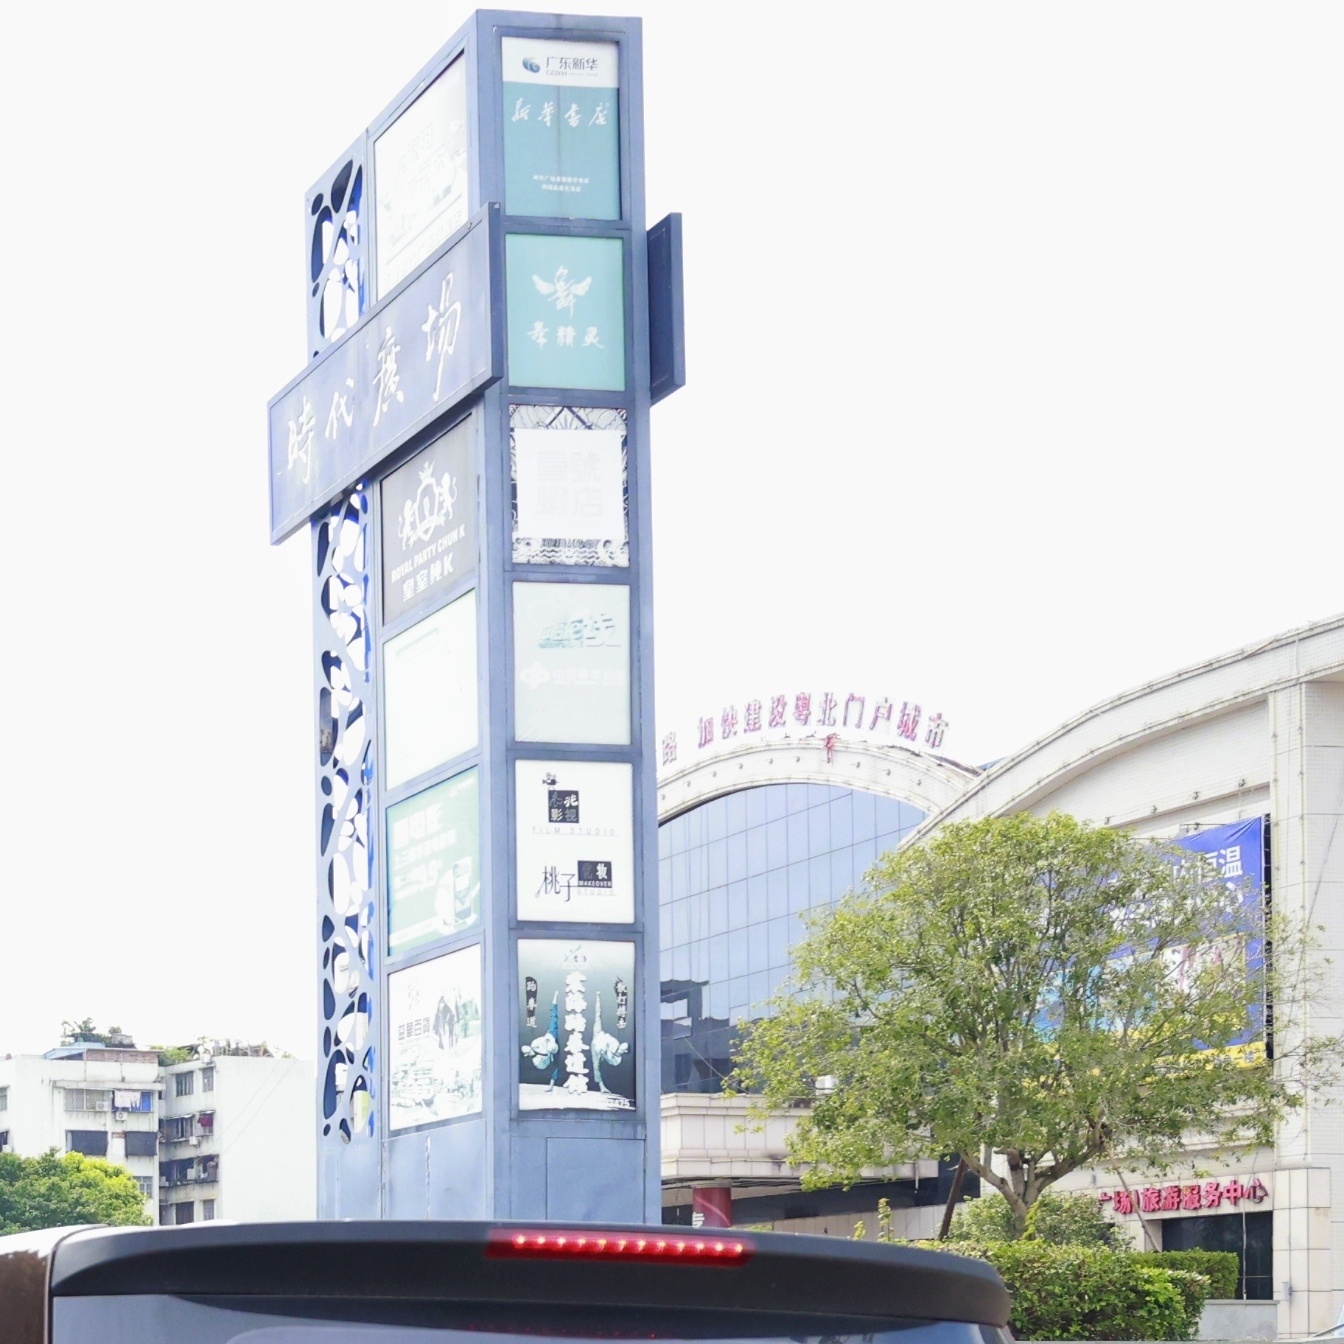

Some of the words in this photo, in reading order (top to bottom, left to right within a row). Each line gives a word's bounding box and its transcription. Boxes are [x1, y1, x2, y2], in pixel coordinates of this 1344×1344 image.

[546, 56, 598, 70] 广东新华
[391, 558, 413, 583] ROYAL
[413, 542, 437, 566] PARTY
[437, 529, 459, 553] CHUN
[697, 692, 949, 748] 加快建设粤北门户城市
[532, 826, 561, 834] FILM
[570, 827, 616, 836] STUDIO
[526, 981, 538, 1029] 跆拳道
